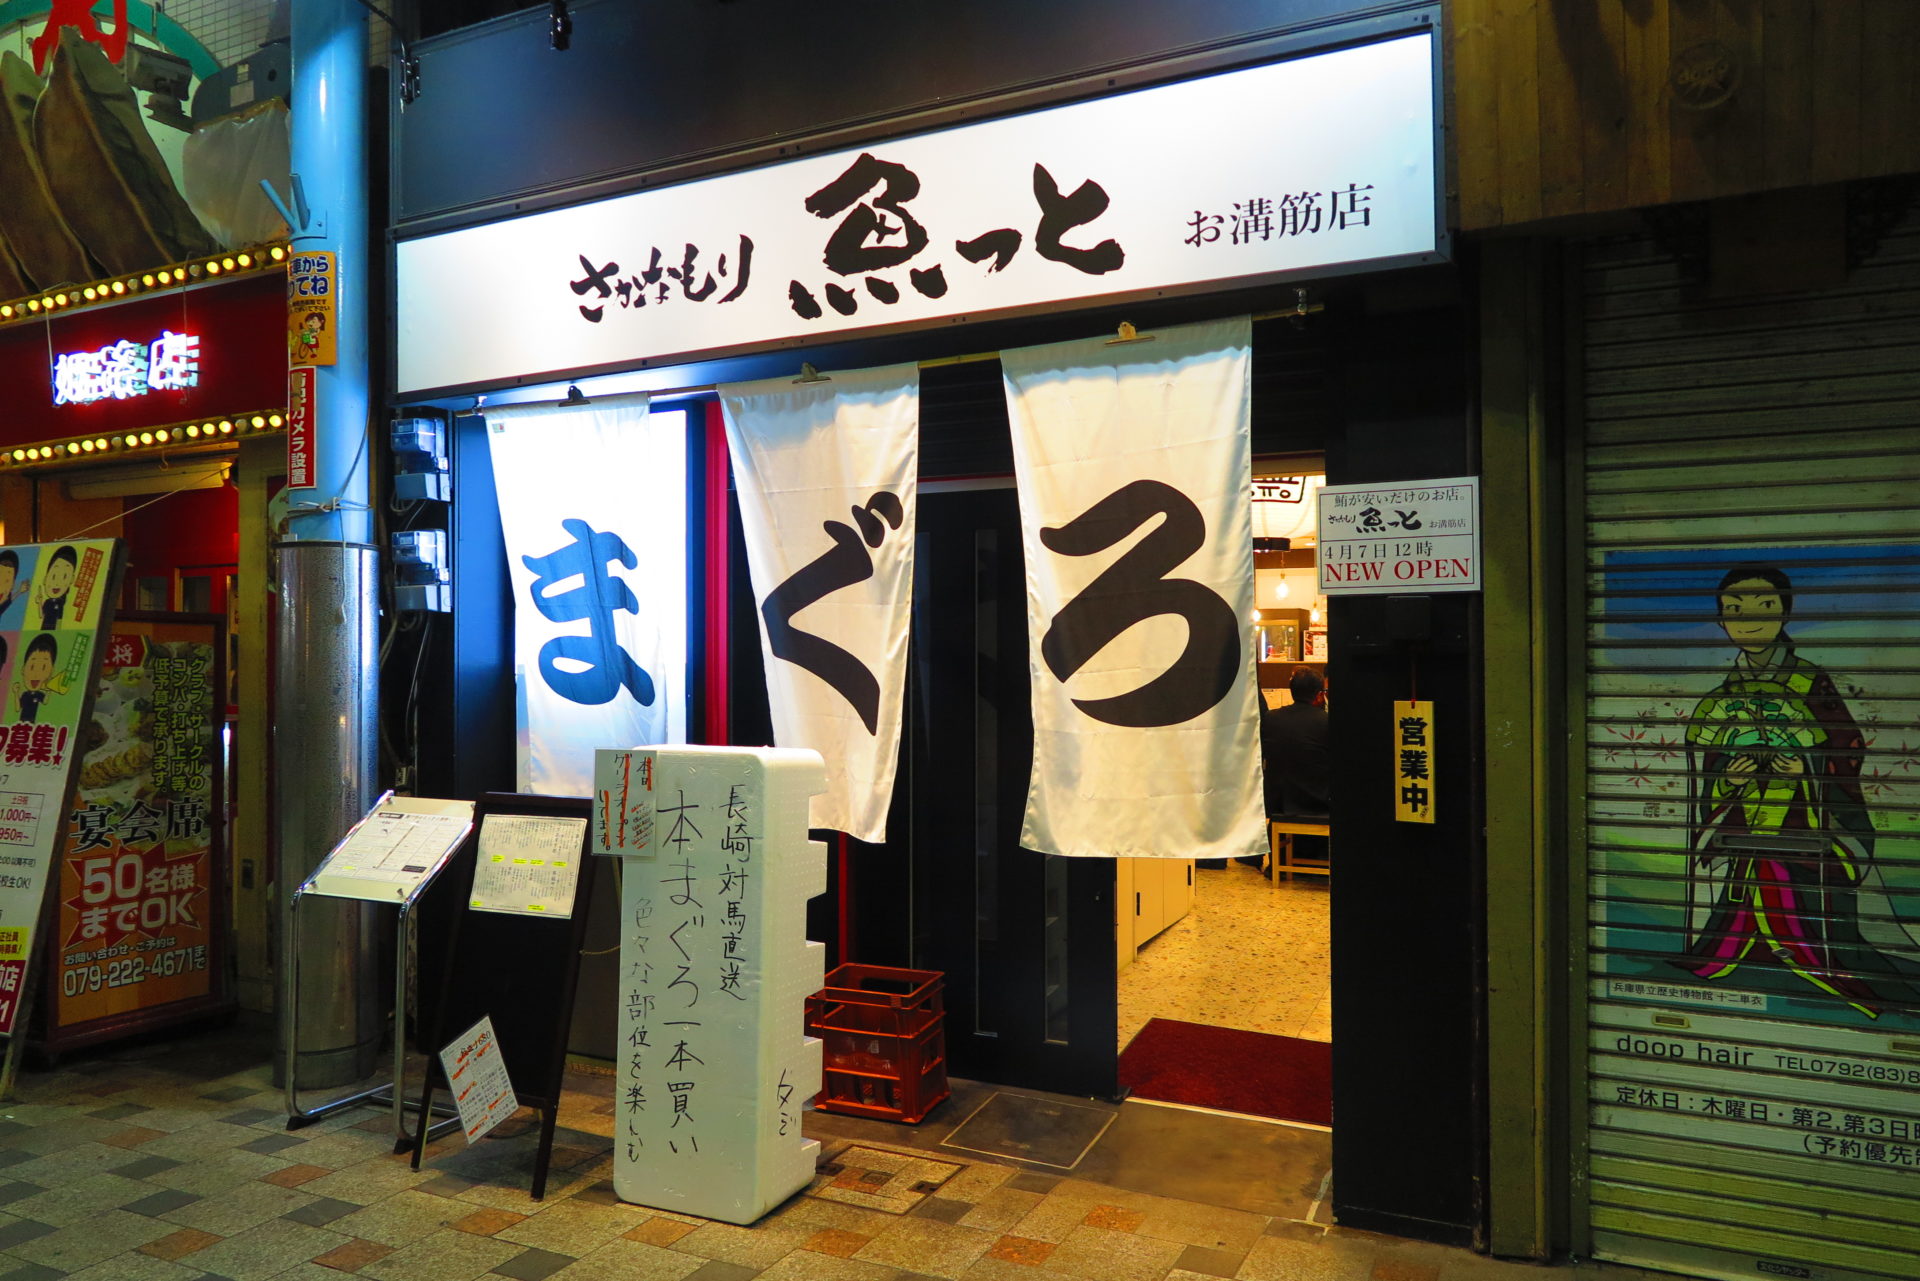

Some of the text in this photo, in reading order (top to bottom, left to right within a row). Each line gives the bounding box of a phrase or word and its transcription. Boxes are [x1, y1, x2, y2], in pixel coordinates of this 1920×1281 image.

[789, 153, 1126, 320] 魚っと
[1184, 183, 1375, 247] お溝筋店
[570, 234, 754, 323] さかなもり
[1334, 488, 1465, 508] 鮪が安いだけのお店。
[1356, 507, 1422, 533] 魚っと
[1429, 519, 1467, 529] お溝筋店
[1325, 558, 1471, 582] NEW OPEN
[1399, 716, 1429, 813] 営業中
[69, 798, 204, 854] 宴会席
[82, 854, 195, 905] 50名様
[718, 784, 754, 1001] 長崎対馬直送
[81, 893, 194, 939] までOK
[657, 789, 705, 1154] 本まぐろ一本買い
[624, 897, 656, 1163] 色々な部位を楽しむ
[1616, 1034, 1684, 1060] doop
[1697, 1042, 1754, 1067] hair
